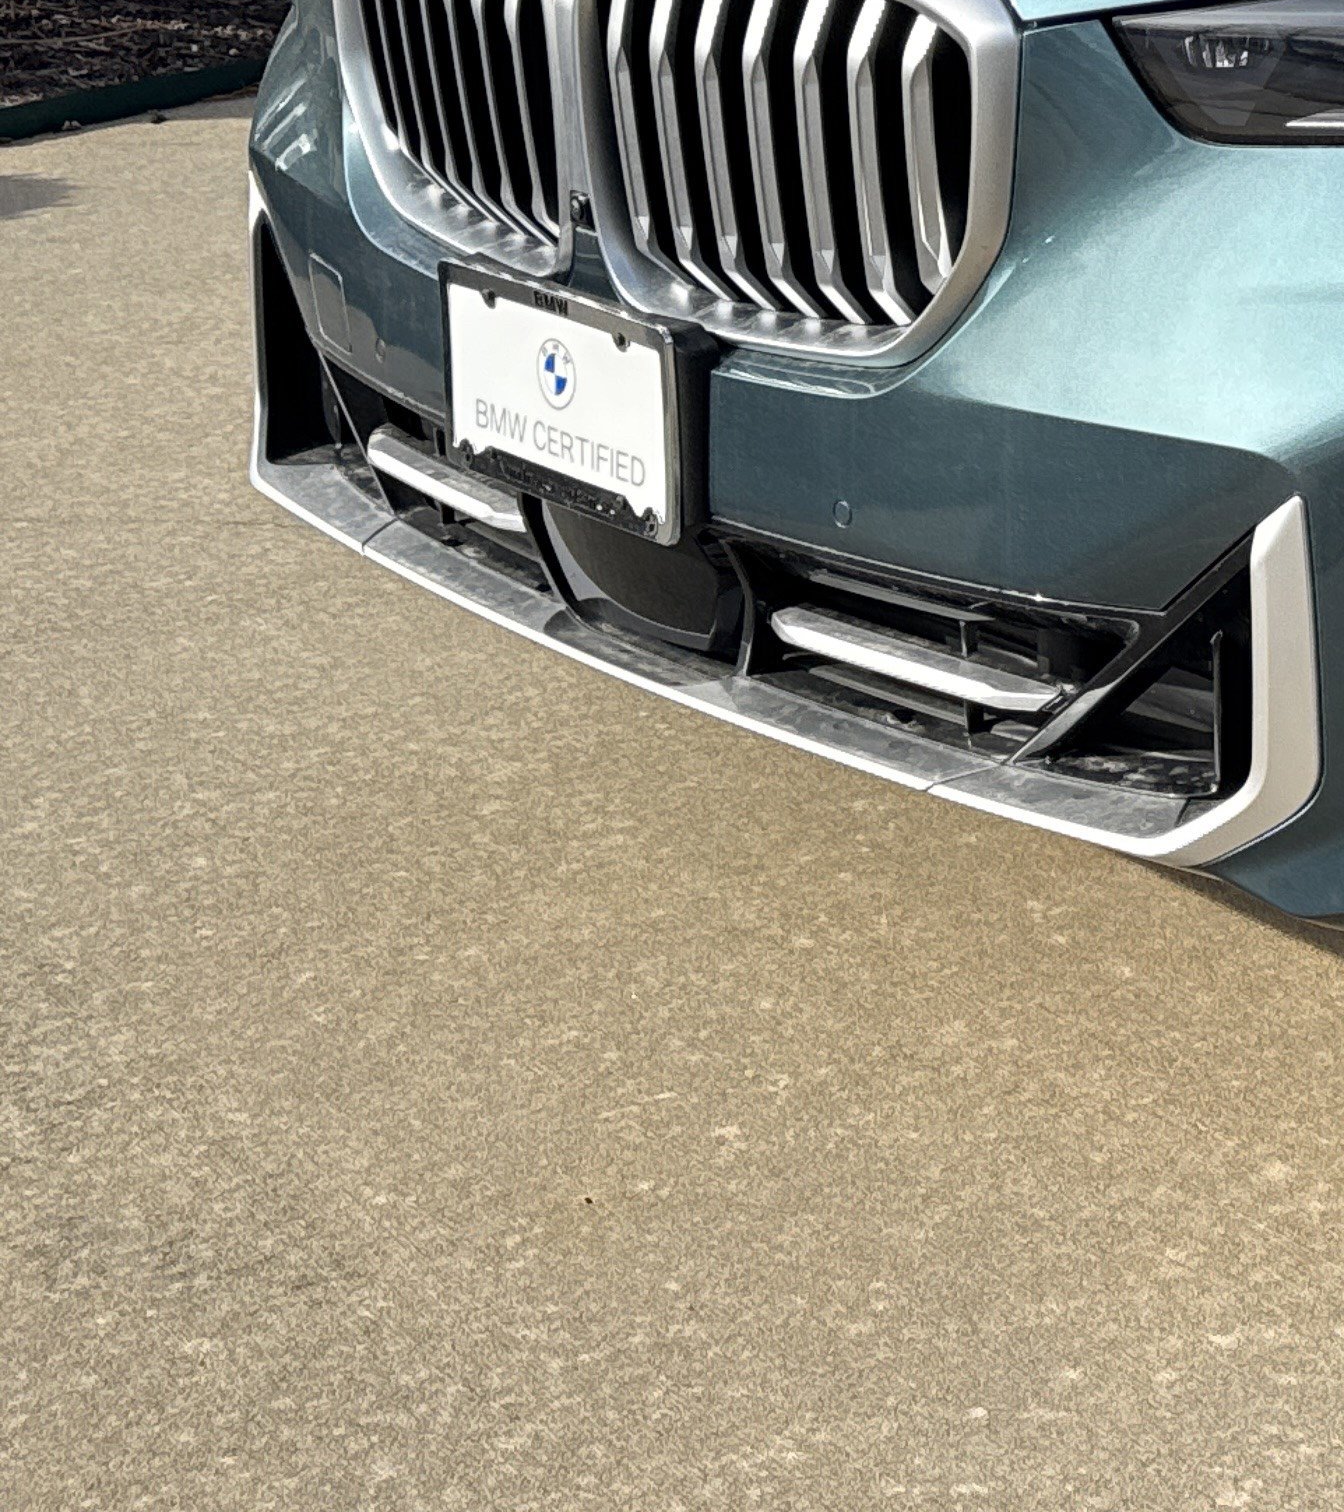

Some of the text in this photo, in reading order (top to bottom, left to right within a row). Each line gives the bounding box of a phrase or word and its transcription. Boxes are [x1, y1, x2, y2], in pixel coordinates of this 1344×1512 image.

[533, 290, 569, 316] BMW
[475, 398, 527, 443] BMW
[533, 420, 646, 487] CERTIFIED
